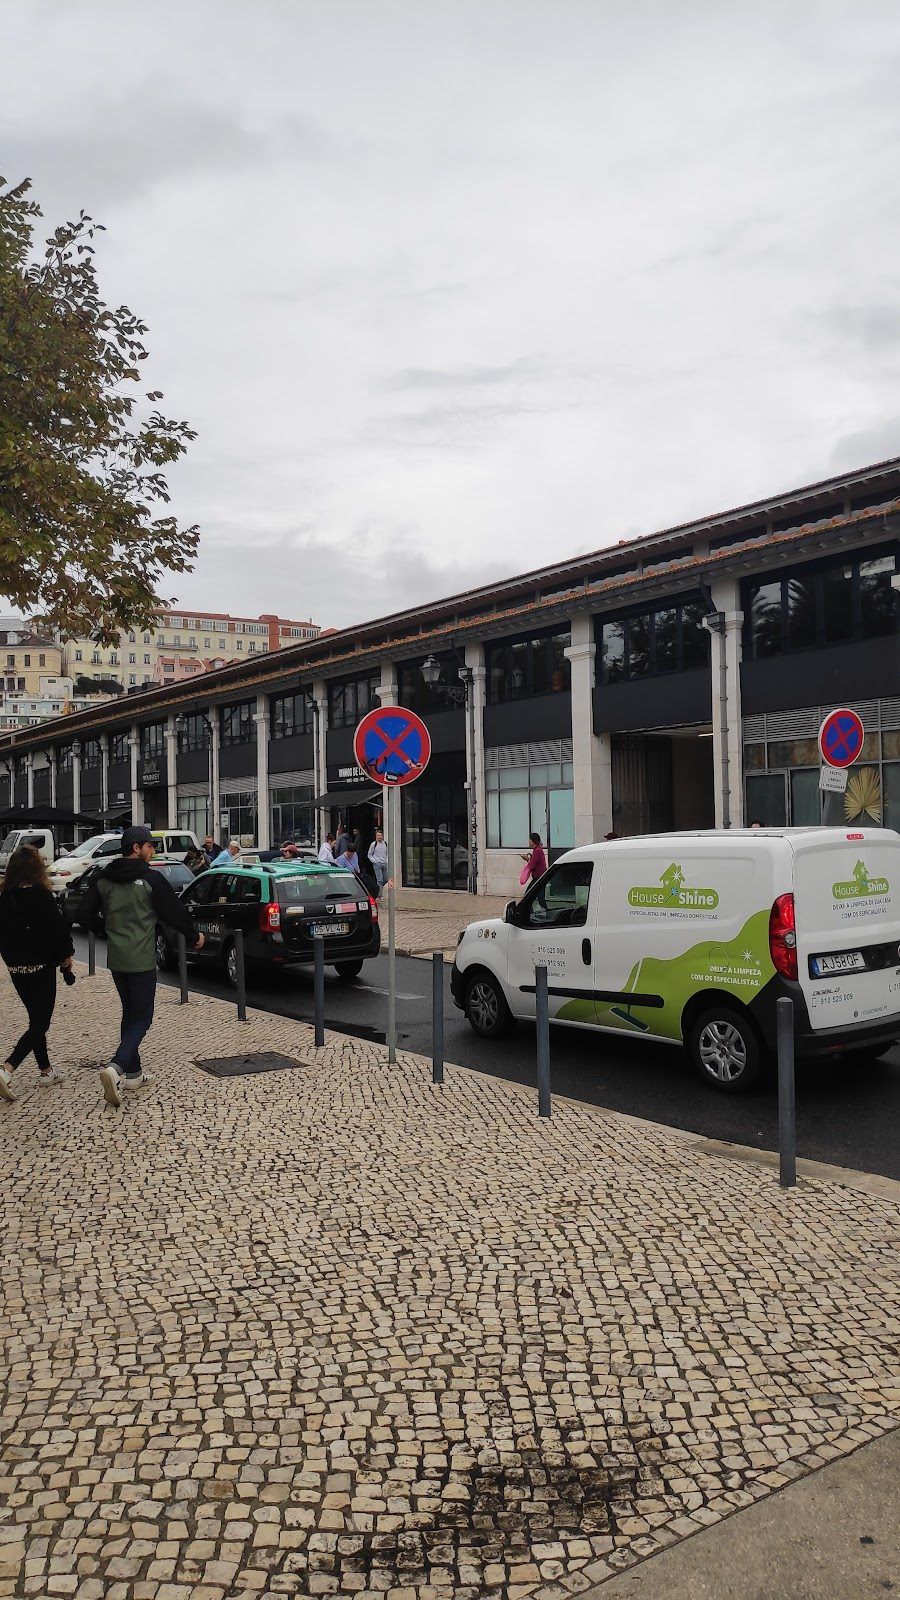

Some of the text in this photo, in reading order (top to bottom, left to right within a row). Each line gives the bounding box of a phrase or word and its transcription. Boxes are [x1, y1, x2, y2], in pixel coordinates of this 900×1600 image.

[352, 767, 358, 776] DE
[834, 882, 887, 896] House Shine
[631, 890, 714, 905] House Shine
